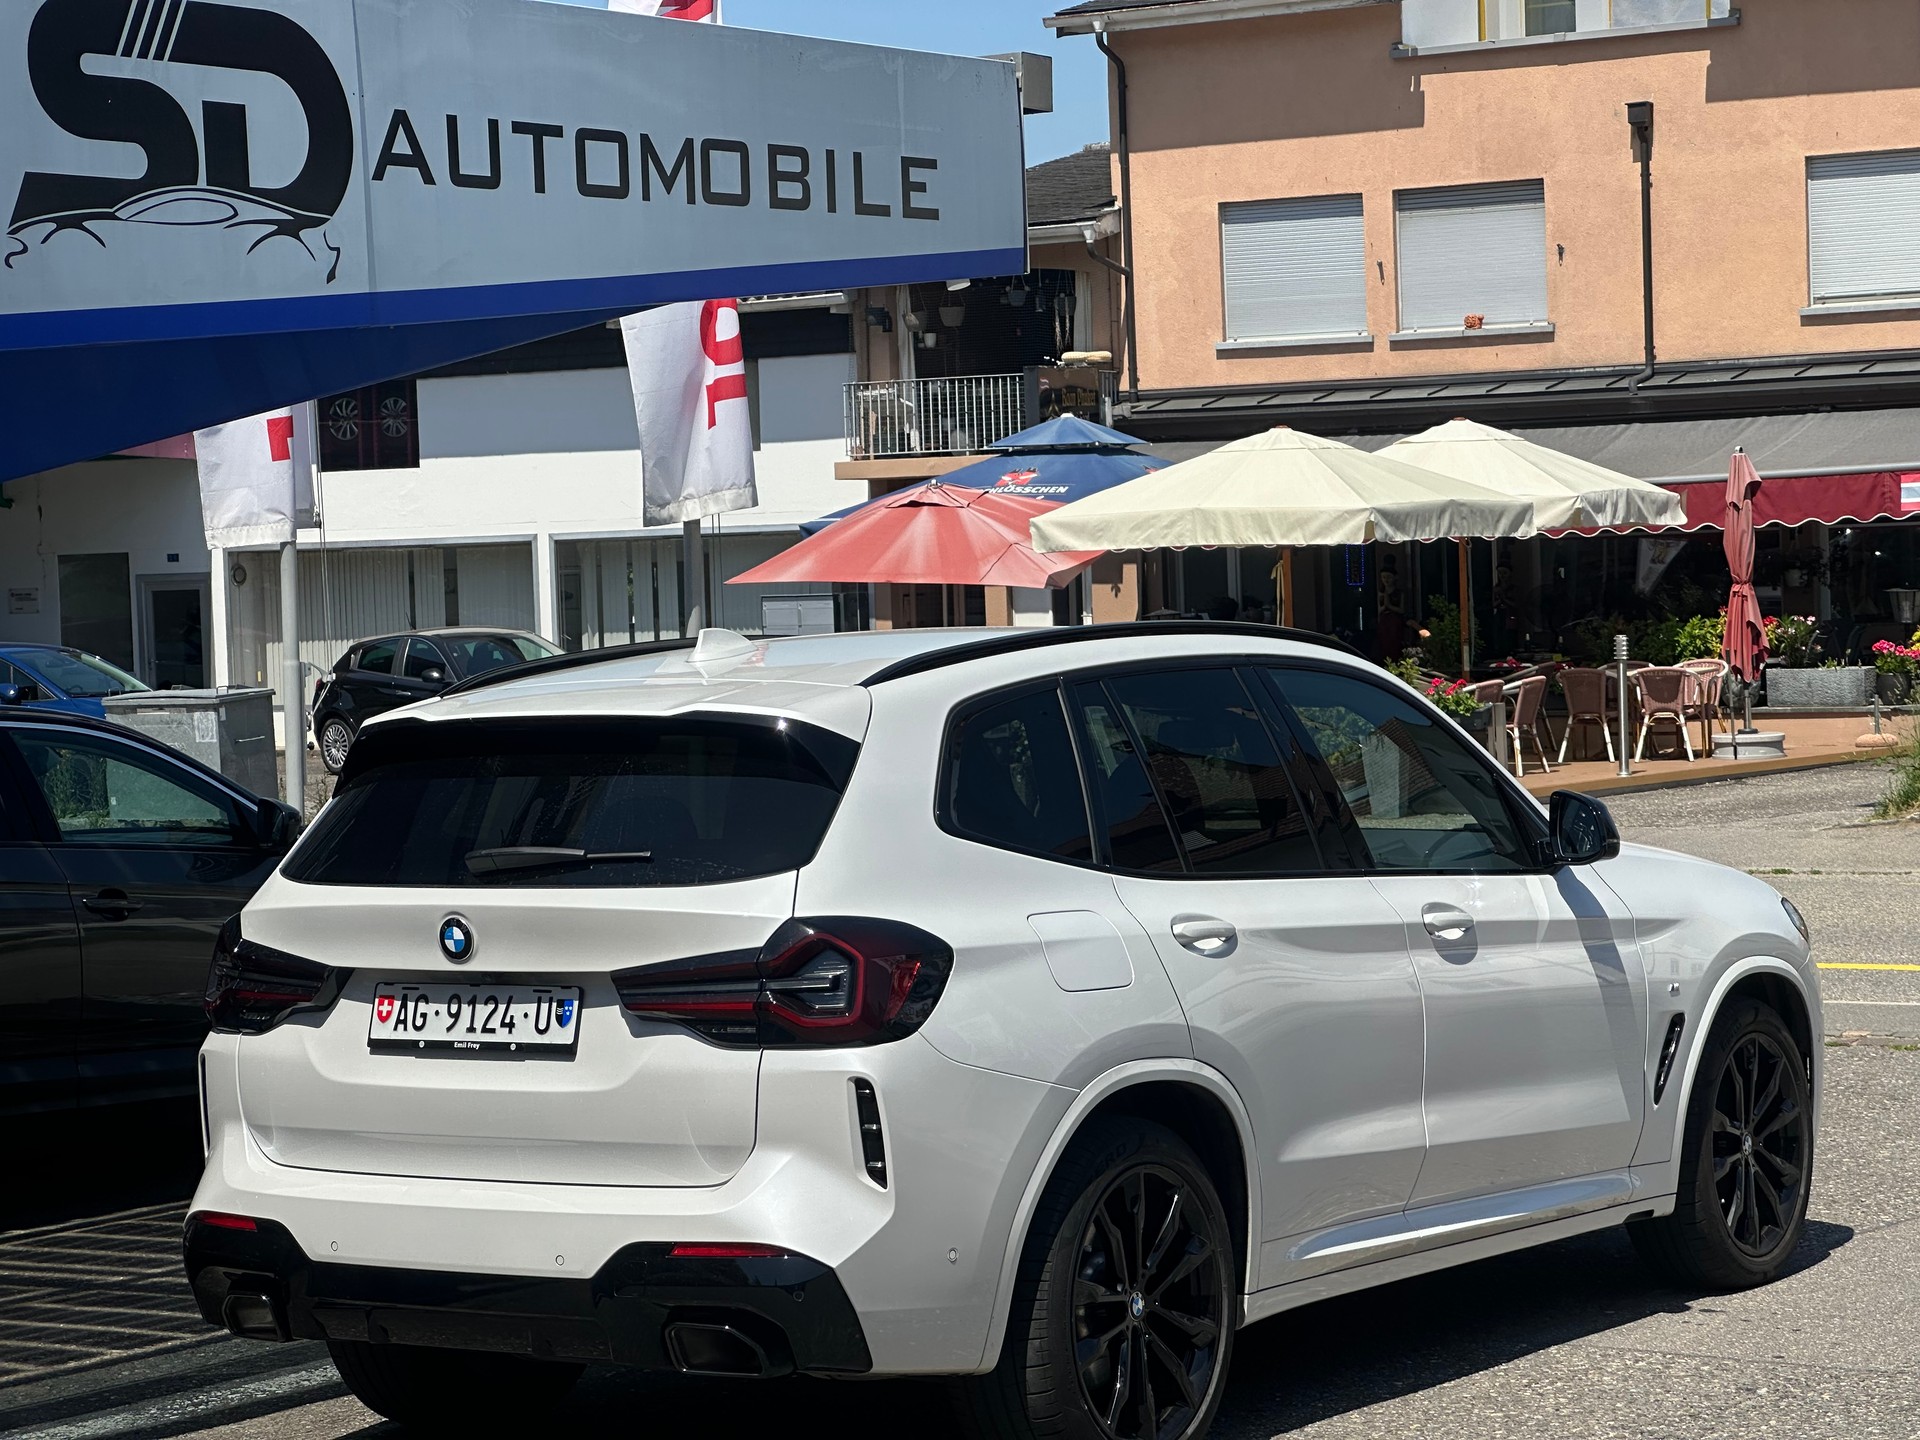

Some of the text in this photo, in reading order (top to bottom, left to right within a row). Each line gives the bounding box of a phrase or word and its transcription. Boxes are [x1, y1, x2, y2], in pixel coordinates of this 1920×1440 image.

[9, 0, 941, 235] SD AUTOMOBILE
[454, 1041, 481, 1050] Emil Frey
